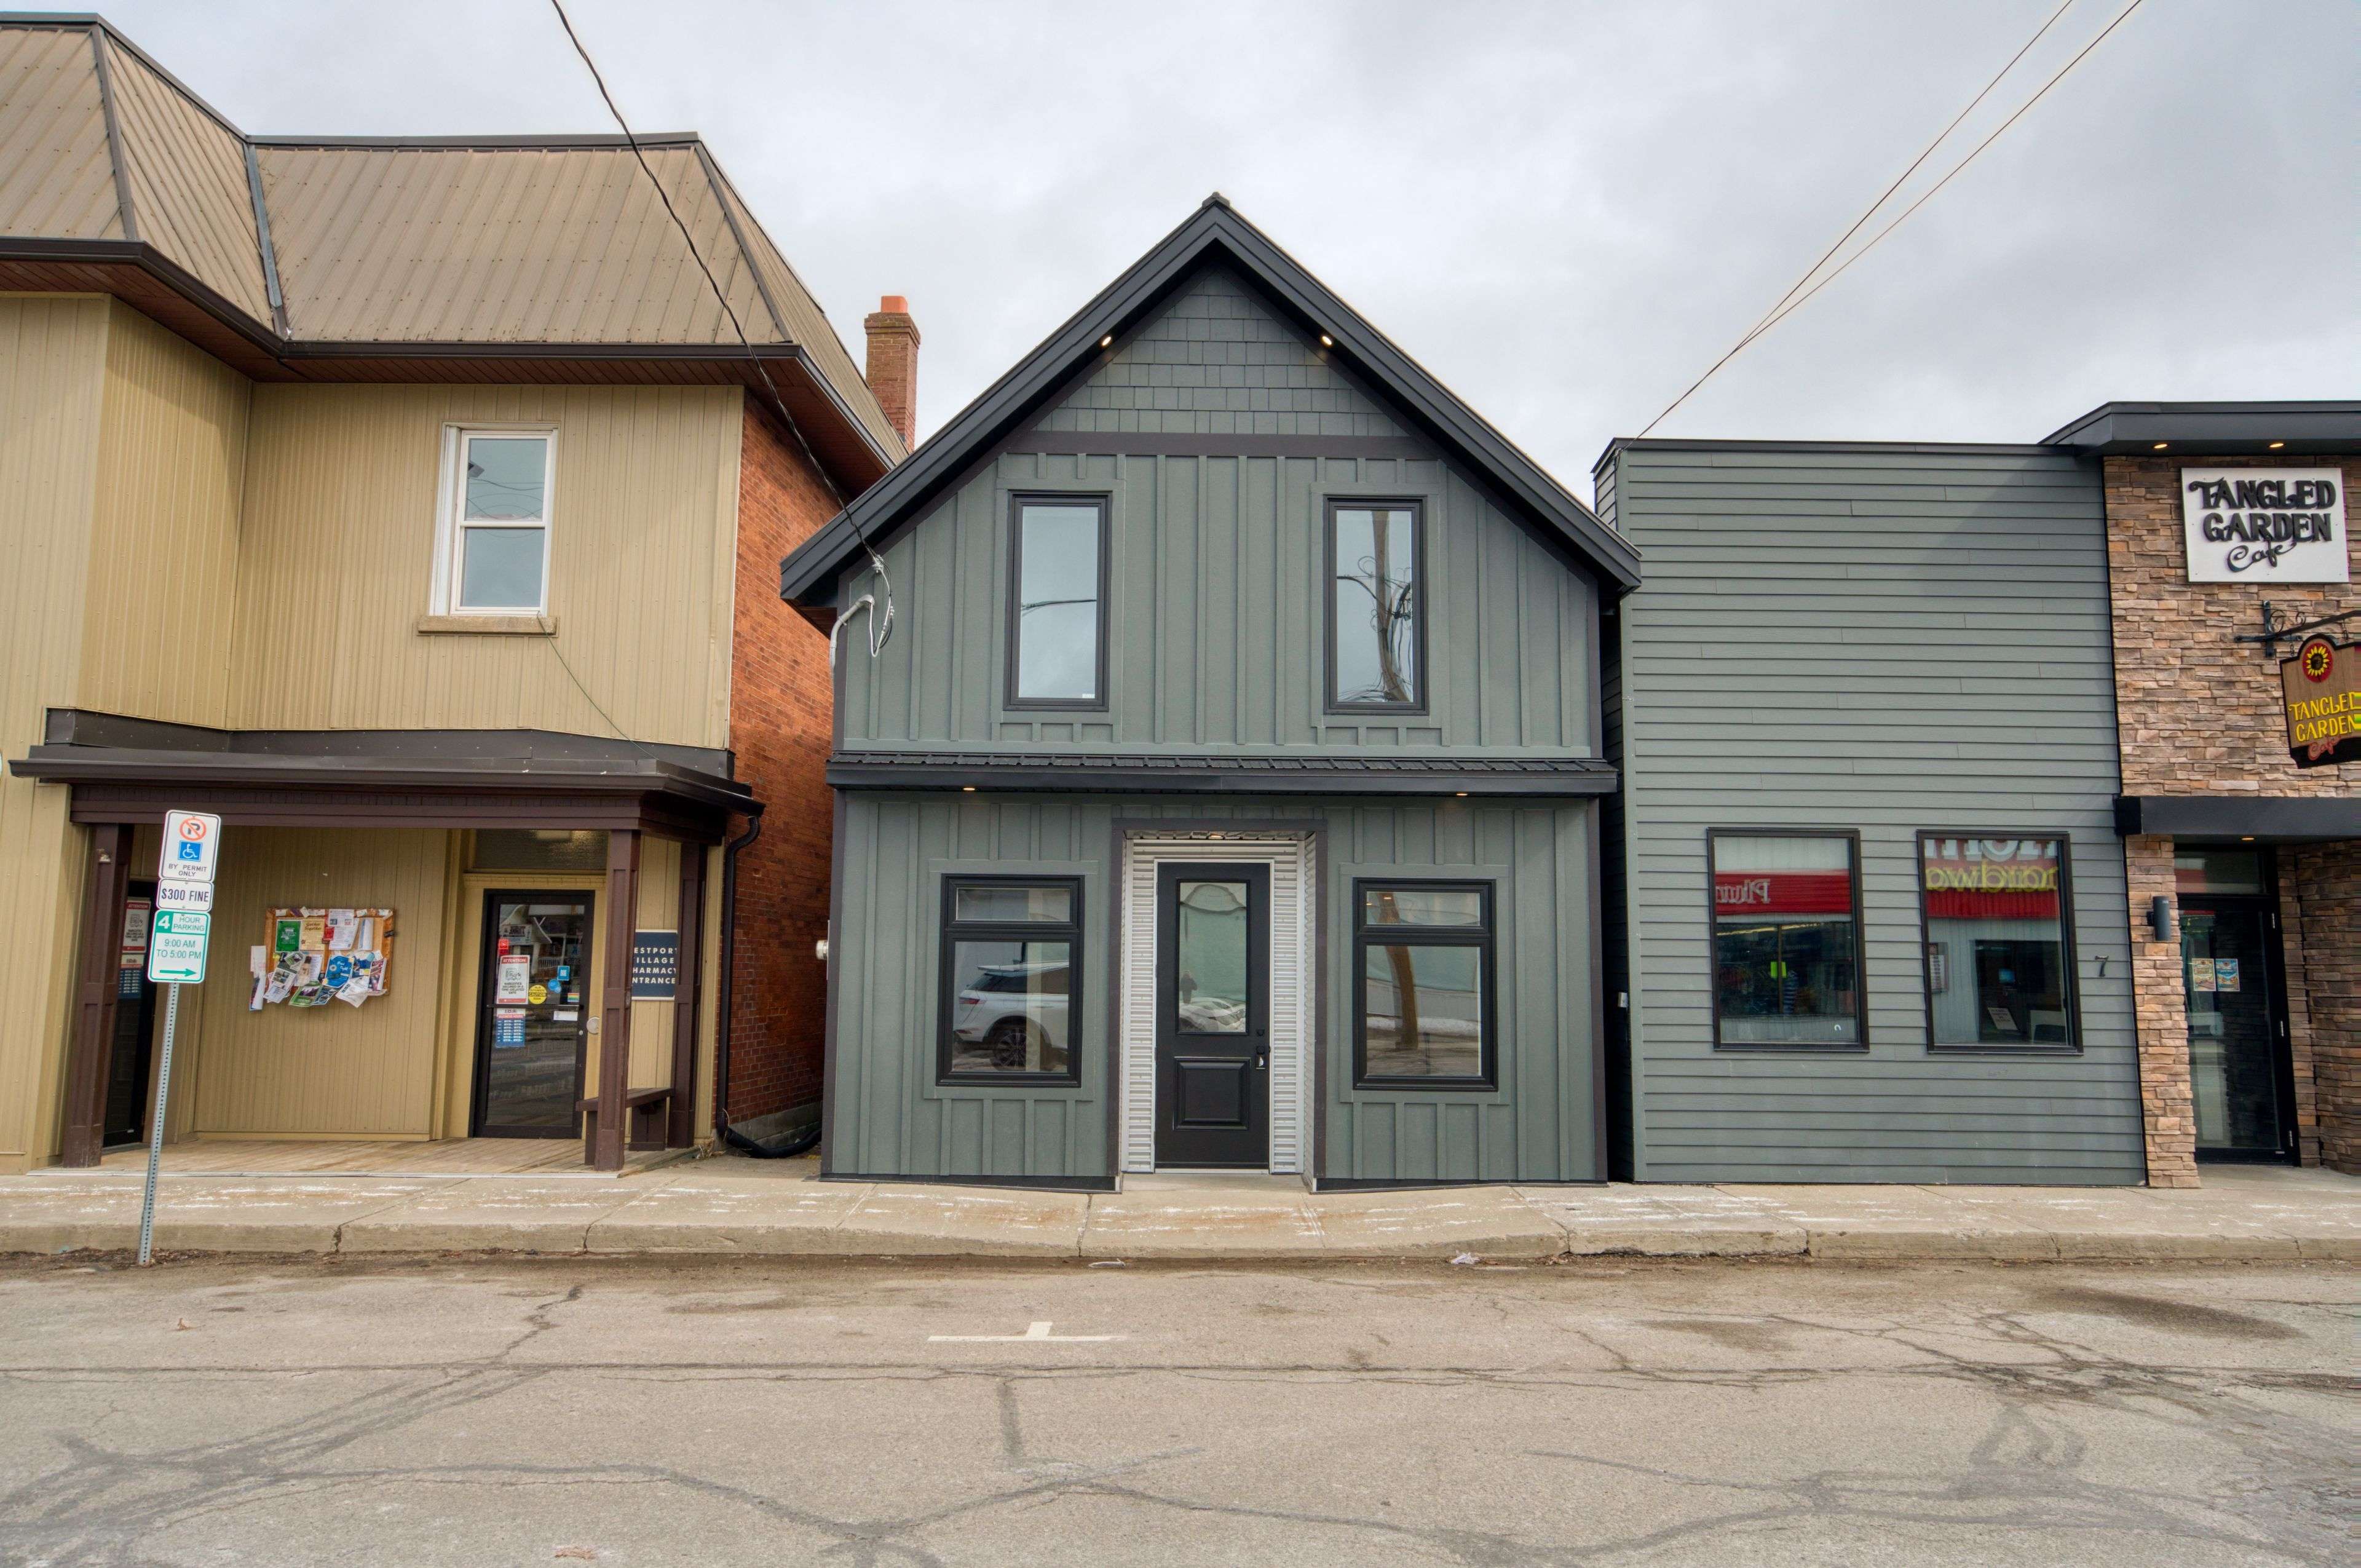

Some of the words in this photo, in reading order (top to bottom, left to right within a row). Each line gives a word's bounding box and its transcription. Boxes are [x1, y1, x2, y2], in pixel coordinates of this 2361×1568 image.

[2188, 477, 2336, 510] TANGLED
[2202, 512, 2332, 542] GARDEN
[161, 888, 186, 900] $300
[189, 890, 209, 902] FINE
[157, 915, 170, 929] 4
[164, 939, 181, 948] 9:00
[156, 949, 168, 957] TO
[170, 950, 187, 959] 5:00
[2095, 955, 2109, 977] 7
